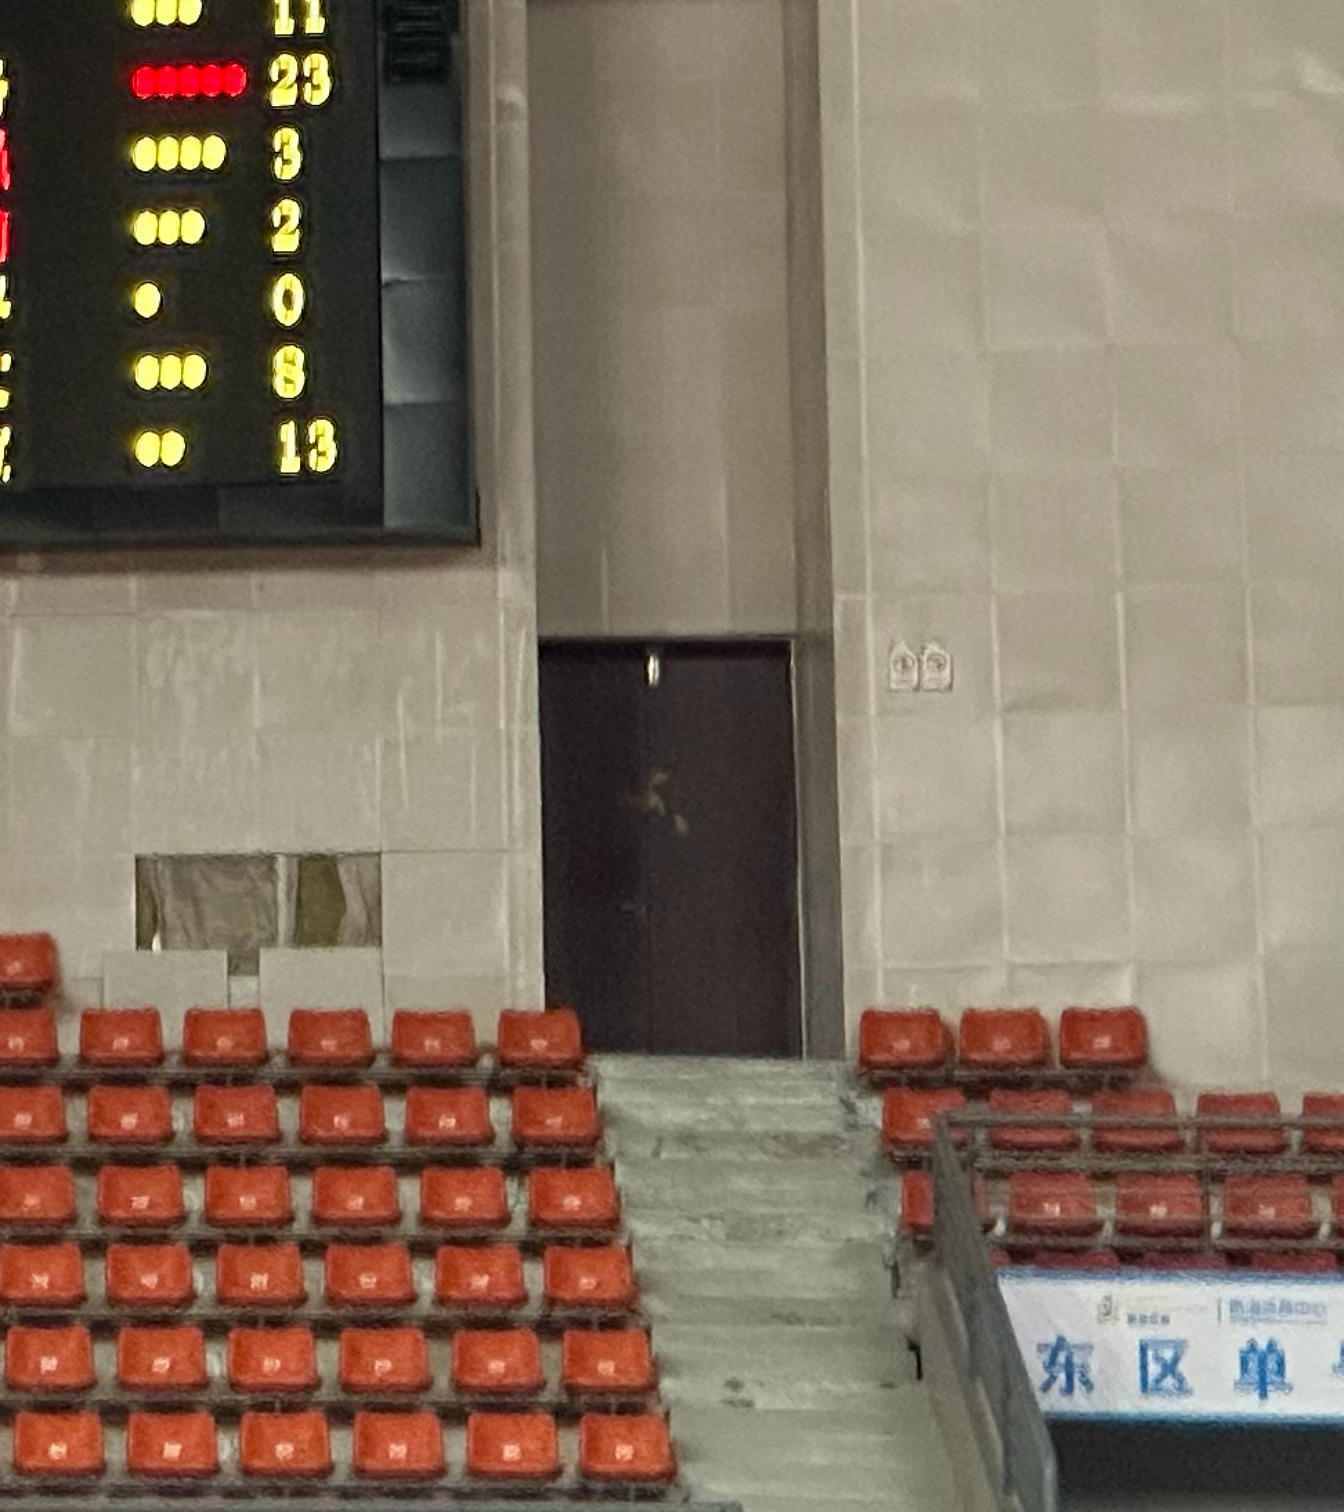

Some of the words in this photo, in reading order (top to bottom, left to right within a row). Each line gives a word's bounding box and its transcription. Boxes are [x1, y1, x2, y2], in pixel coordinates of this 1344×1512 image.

[269, 53, 332, 106] 23
[273, 128, 302, 179] 3
[271, 199, 301, 251] 2
[271, 273, 304, 326] 0
[280, 420, 337, 473] 13
[1036, 1335, 1344, 1400] 东区单
